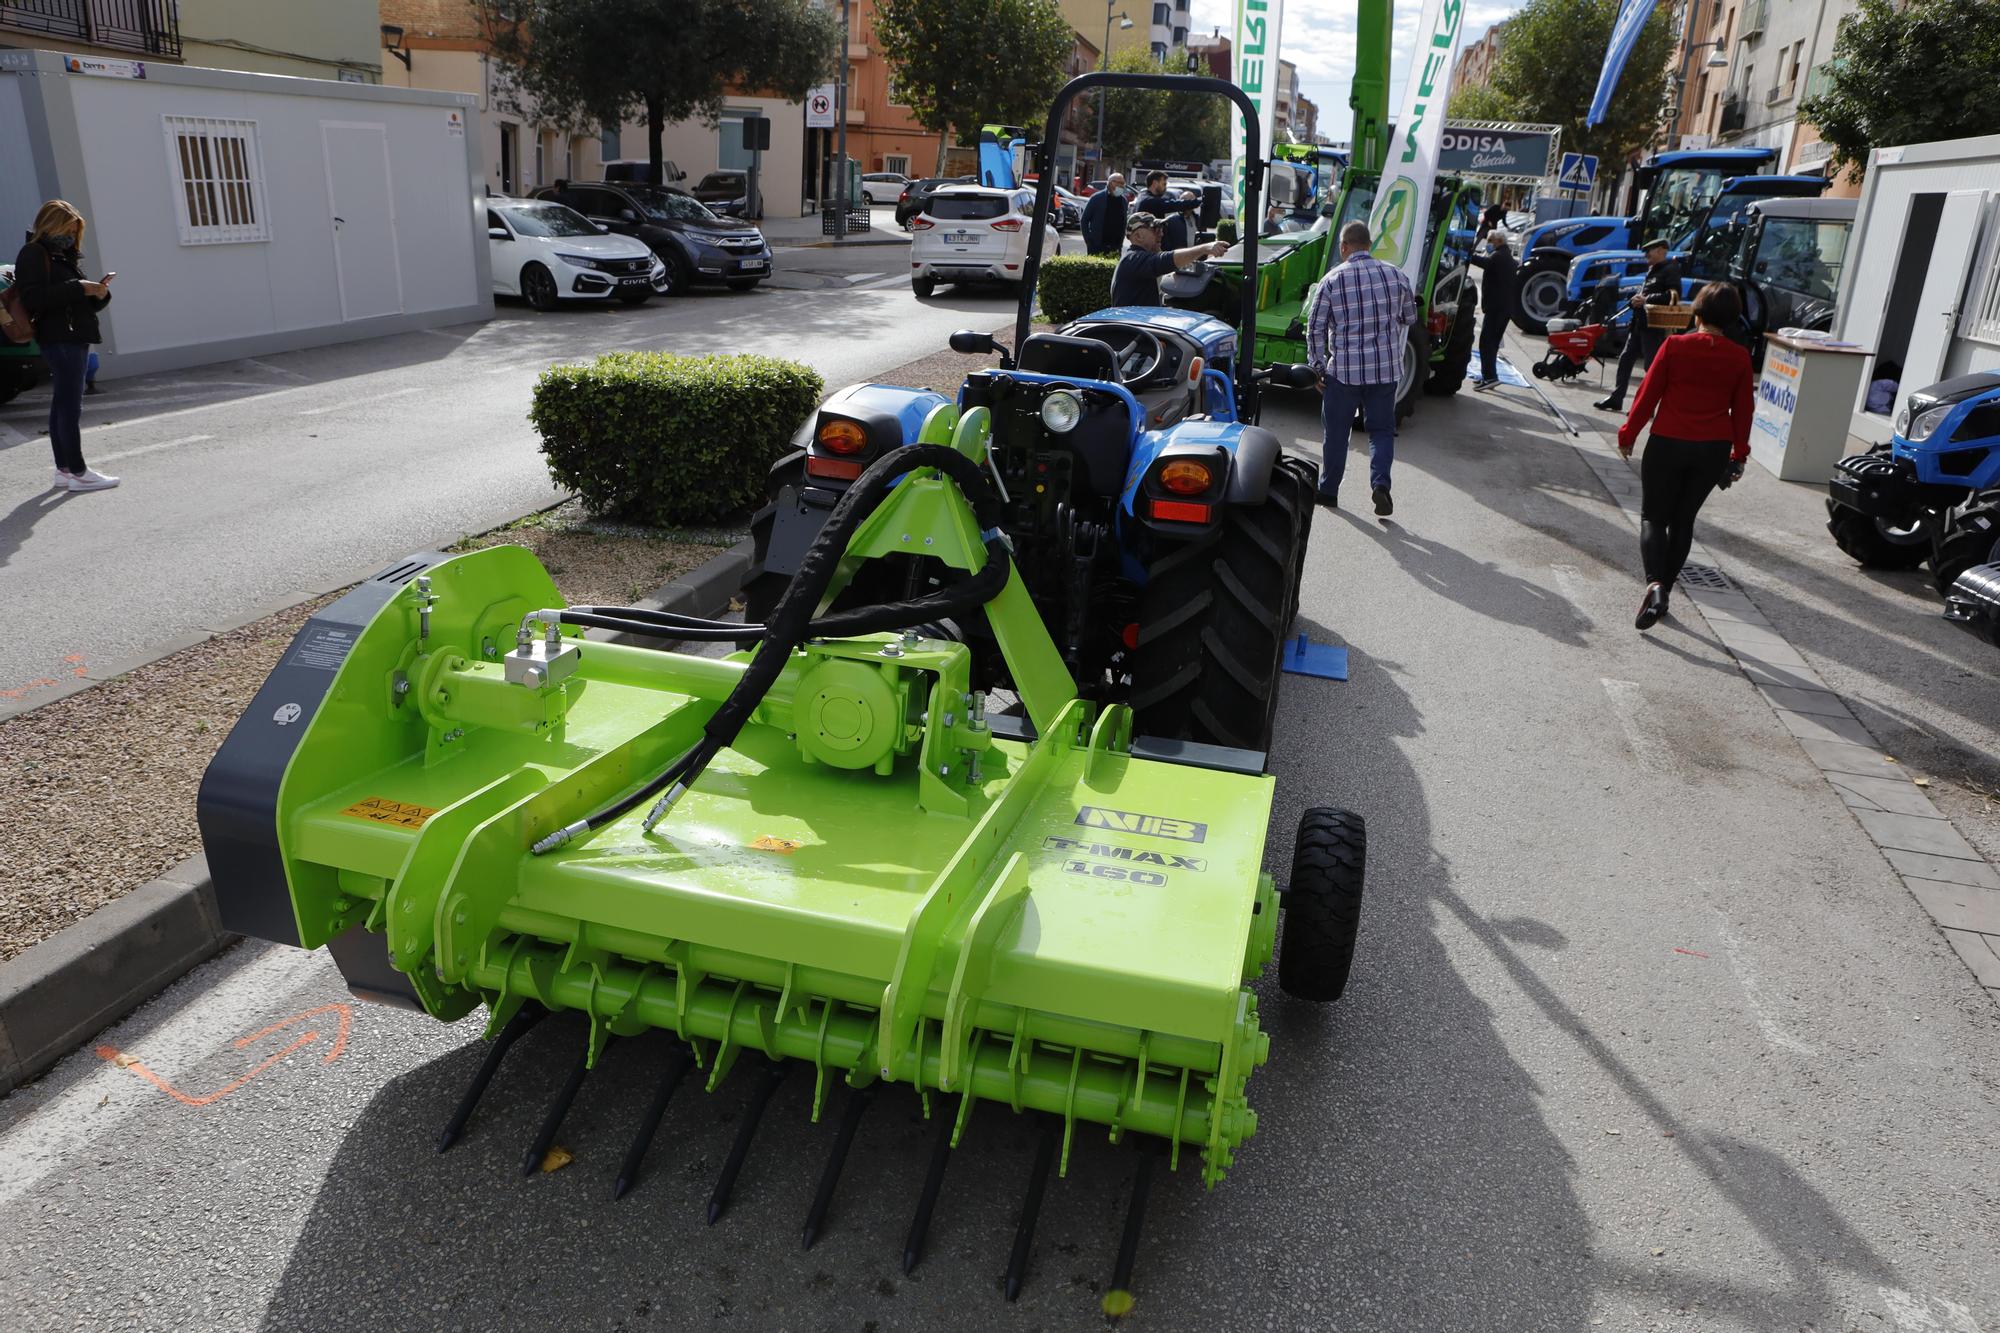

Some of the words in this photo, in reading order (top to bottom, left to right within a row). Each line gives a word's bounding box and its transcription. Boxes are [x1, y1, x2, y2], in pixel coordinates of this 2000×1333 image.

[622, 277, 648, 286] CIVIC
[1760, 379, 1796, 414] KOMATSU
[1049, 837, 1200, 871] T-MAX
[1065, 861, 1165, 886] 160
